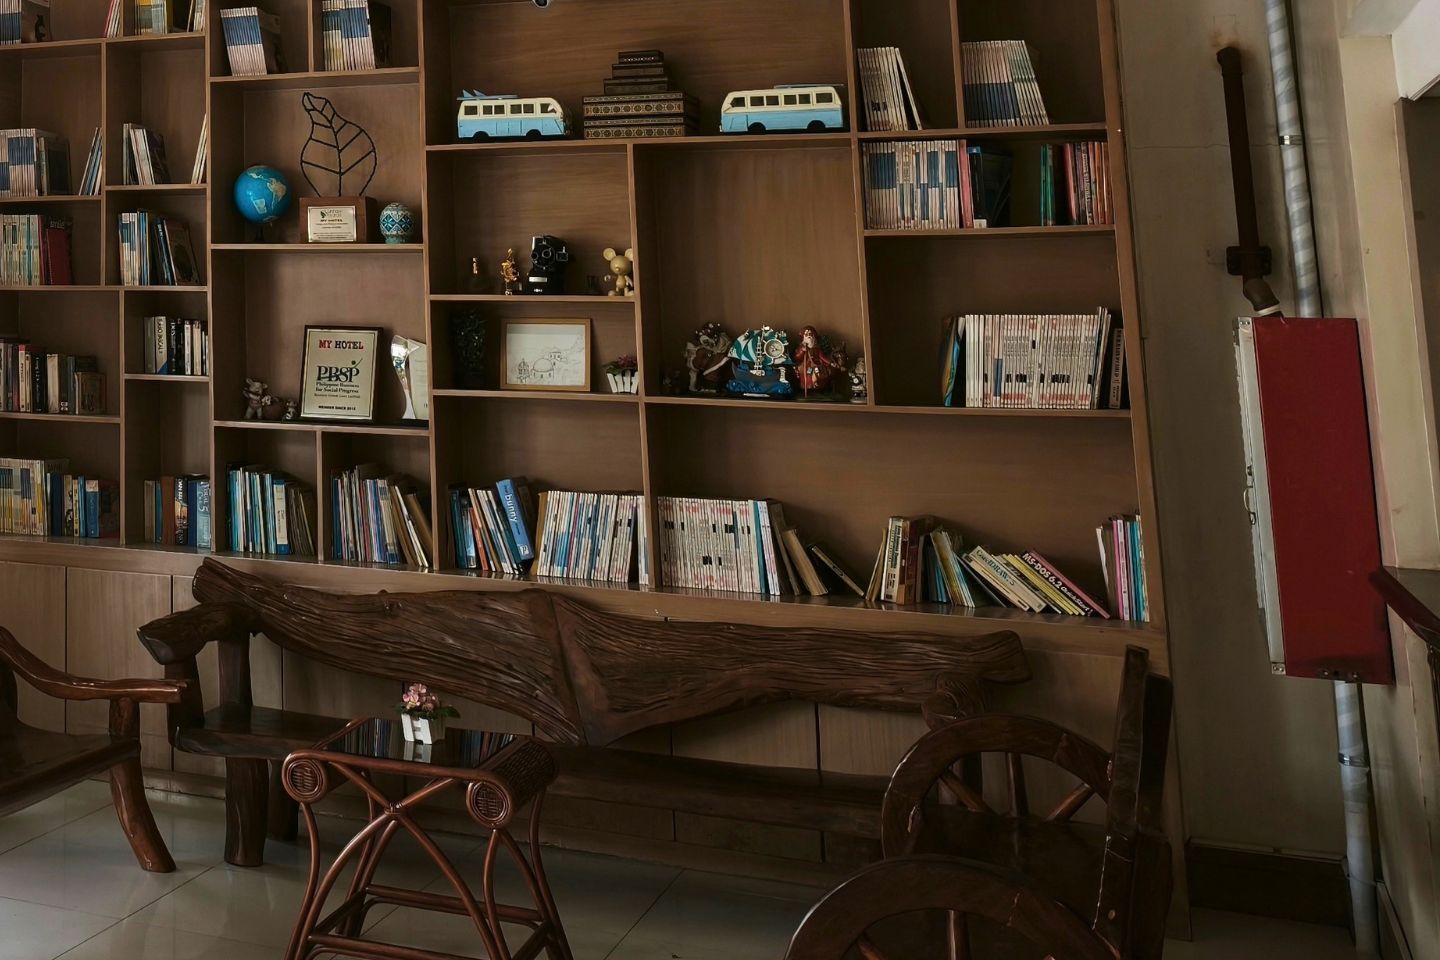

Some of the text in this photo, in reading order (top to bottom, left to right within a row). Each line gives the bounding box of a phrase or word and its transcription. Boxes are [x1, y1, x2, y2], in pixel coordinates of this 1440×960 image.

[318, 340, 364, 350] MY HOTEL
[316, 365, 360, 383] PBSP
[505, 494, 517, 522] bunny
[1022, 552, 1051, 578] MS-DOS
[1048, 574, 1062, 591] 6.2
